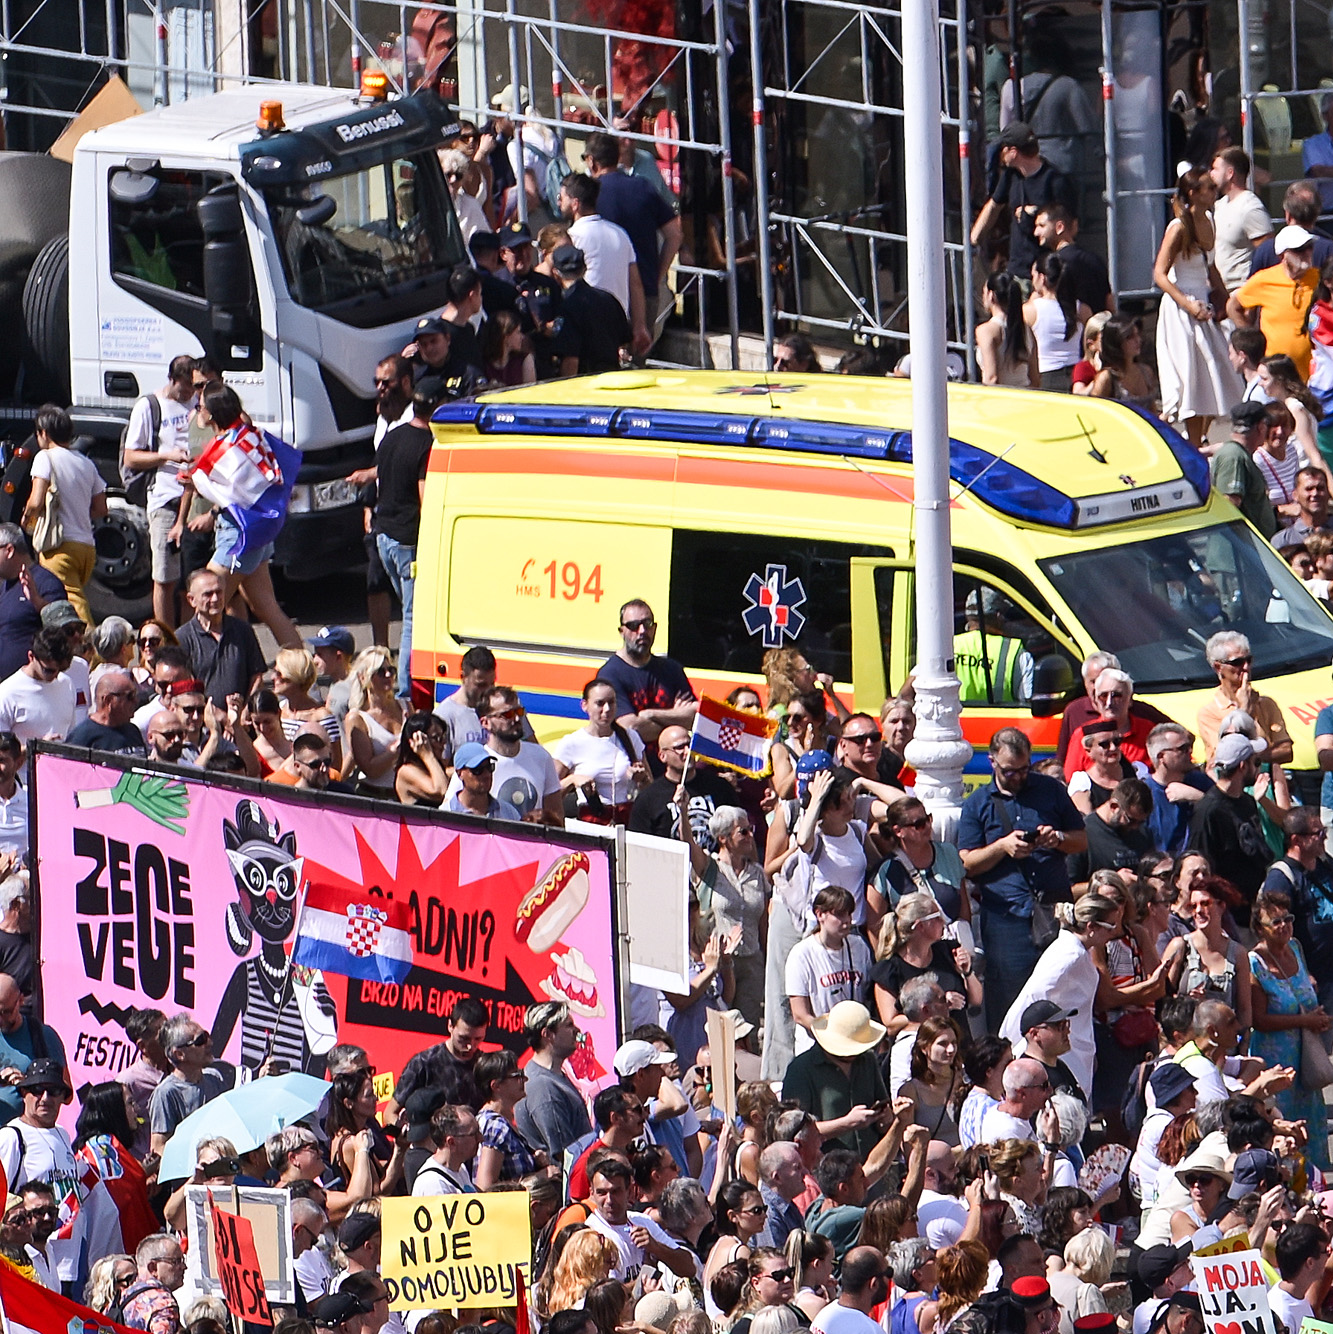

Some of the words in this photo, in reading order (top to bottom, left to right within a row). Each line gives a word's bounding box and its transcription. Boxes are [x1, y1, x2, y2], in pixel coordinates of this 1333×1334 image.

[336, 109, 405, 142] Benussi
[1130, 496, 1160, 512] HITNA
[544, 559, 604, 602] 194
[368, 886, 495, 977] ADNI?
[361, 980, 399, 1007] BRZO
[402, 984, 423, 1012] NA
[74, 1032, 138, 1073] FESTIV
[414, 1199, 485, 1233] OVO
[400, 1231, 472, 1267] NIJE
[1203, 1260, 1266, 1293] MOJA
